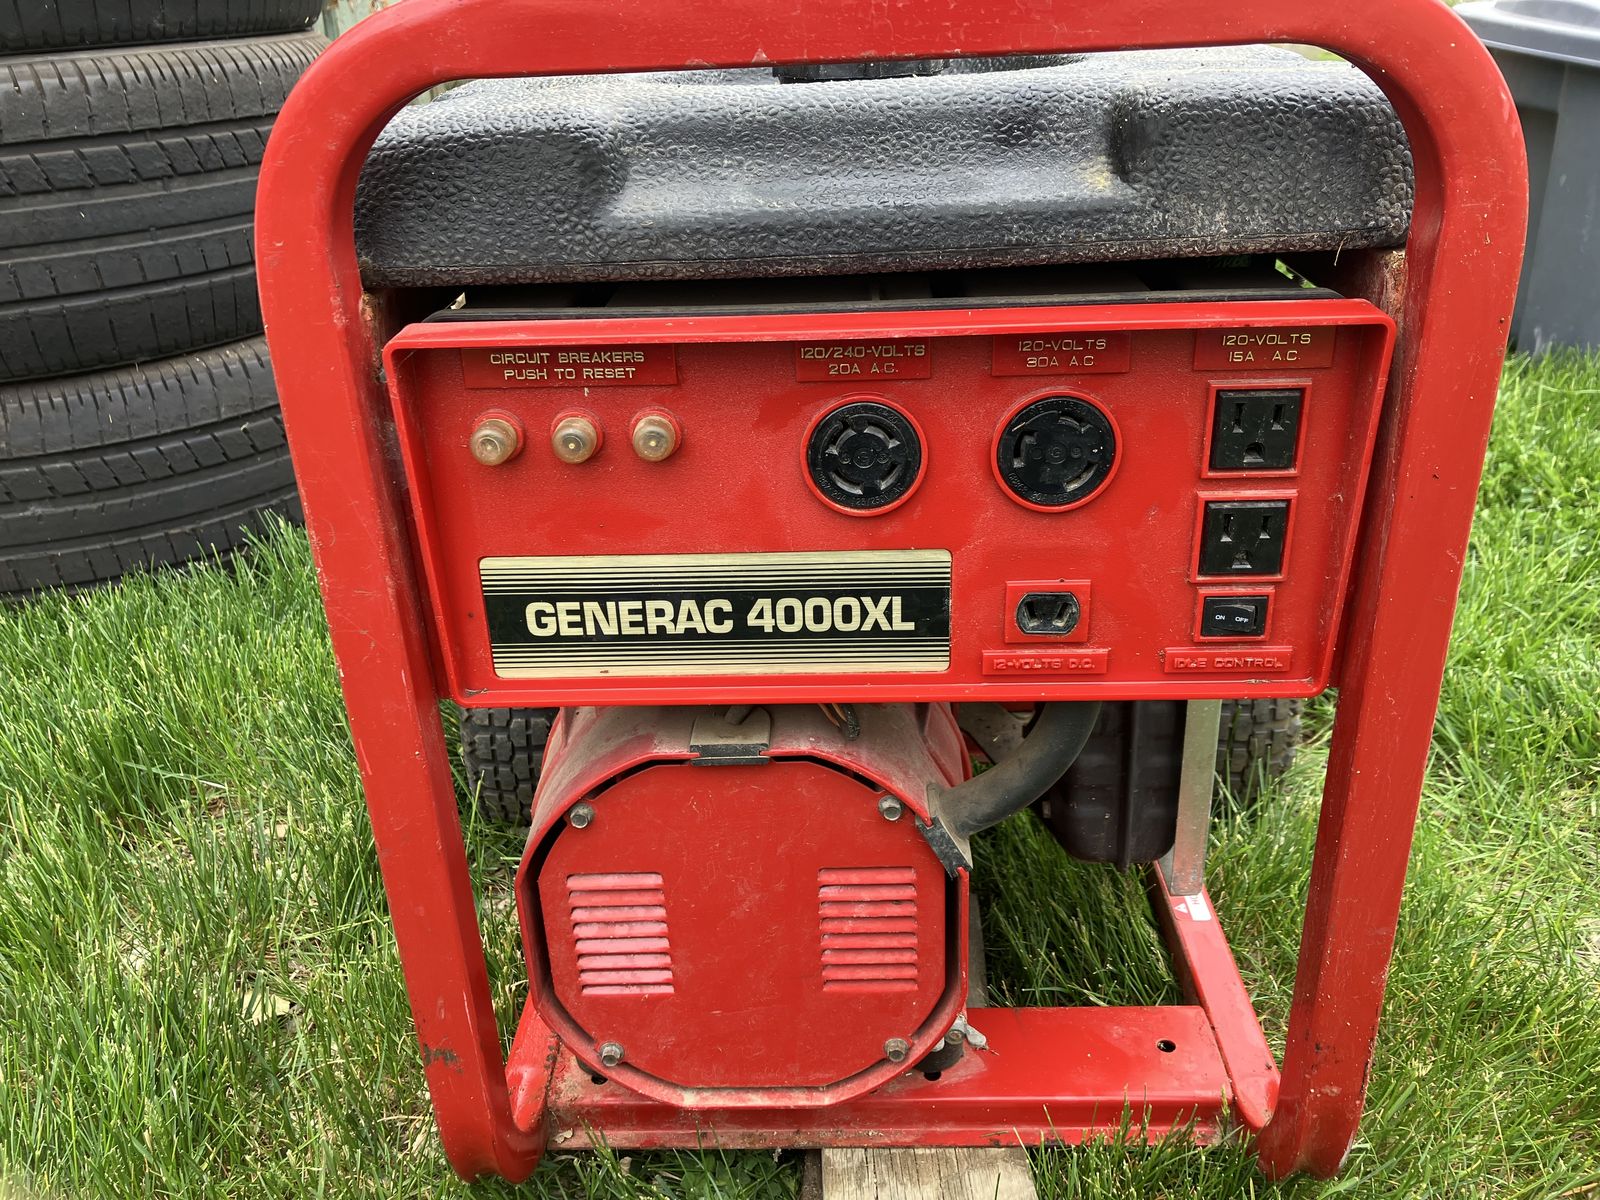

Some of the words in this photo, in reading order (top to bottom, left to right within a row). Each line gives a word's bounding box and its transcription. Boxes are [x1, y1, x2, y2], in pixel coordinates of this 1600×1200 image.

[1018, 339, 1106, 352] 120-VOLTS
[1222, 333, 1311, 346] 120-VOLTS
[490, 352, 551, 365] CIRCUIT
[558, 351, 645, 364] BREAKERS
[800, 344, 925, 359] 120/240-VOLTS
[1228, 351, 1255, 362] 15A
[1026, 356, 1059, 368] 30A
[504, 368, 548, 380] PUSH
[554, 368, 576, 380] TO
[582, 367, 636, 379] RESET
[828, 363, 861, 375] 20A
[525, 598, 734, 637] GENERAC
[746, 595, 916, 634] 4000XL
[993, 658, 1064, 670] 12-VOLTS
[1174, 657, 1208, 668] IDLE
[1214, 656, 1283, 668] CONTROL
